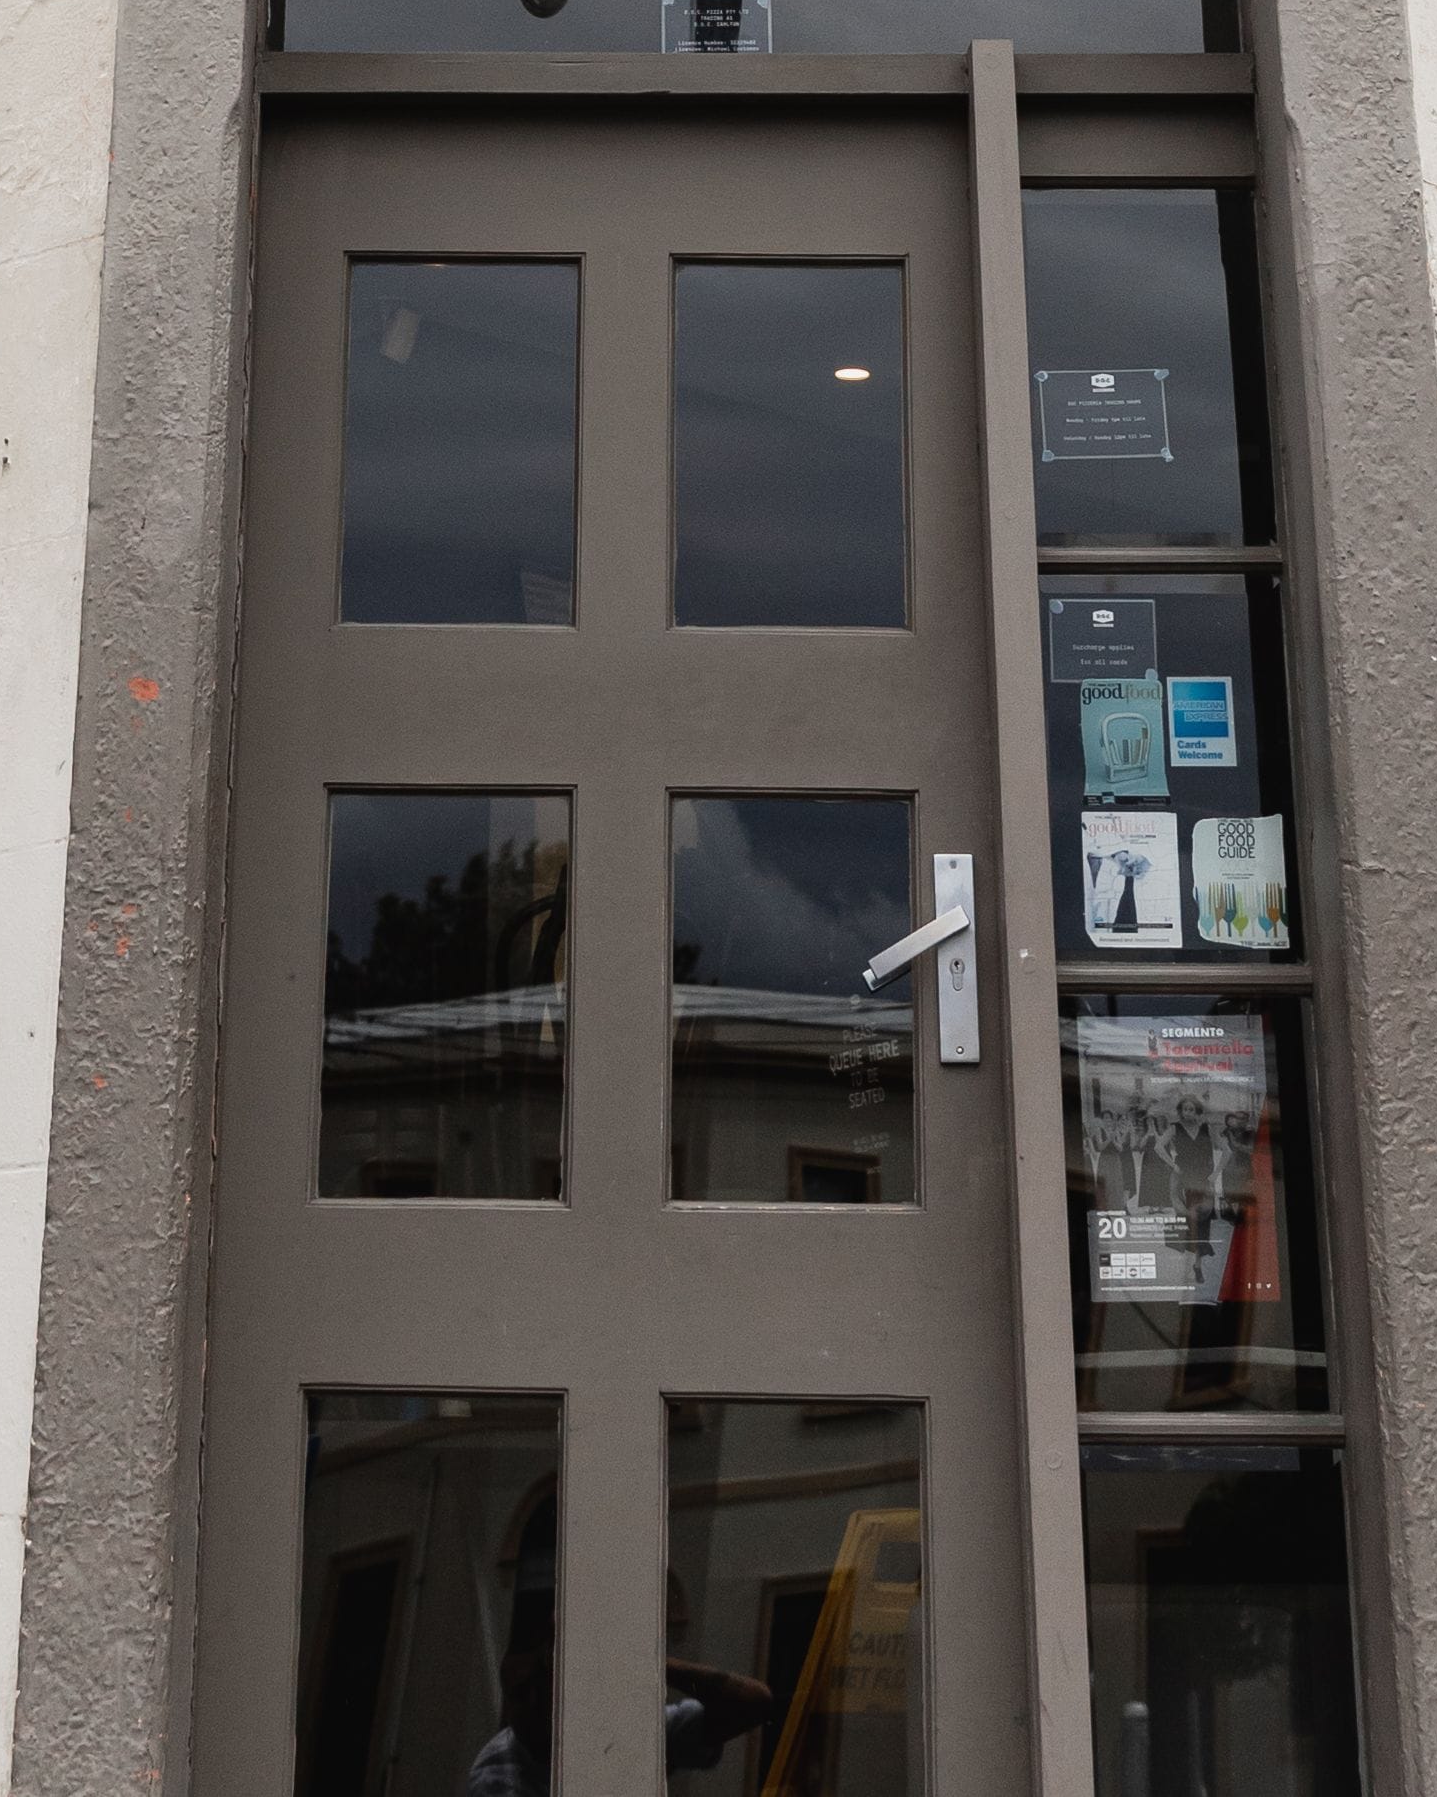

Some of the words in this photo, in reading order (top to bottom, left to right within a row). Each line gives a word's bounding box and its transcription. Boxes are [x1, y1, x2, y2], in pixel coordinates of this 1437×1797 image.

[1173, 701, 1224, 710] AMERICAN
[1185, 712, 1229, 720] EXPRESS
[1177, 740, 1207, 749] Cards
[1178, 750, 1224, 759] Welcome
[1217, 822, 1255, 835] GOOD
[1218, 834, 1256, 847] FOOD
[1218, 846, 1256, 859] GUIDE
[1161, 1027, 1225, 1038] SEGMENTO
[1162, 1039, 1255, 1056] Tarantella
[829, 1048, 864, 1076] QUEUE
[868, 1039, 901, 1063] HERE
[848, 1087, 886, 1109] SEATED
[1098, 1217, 1127, 1239] 20
